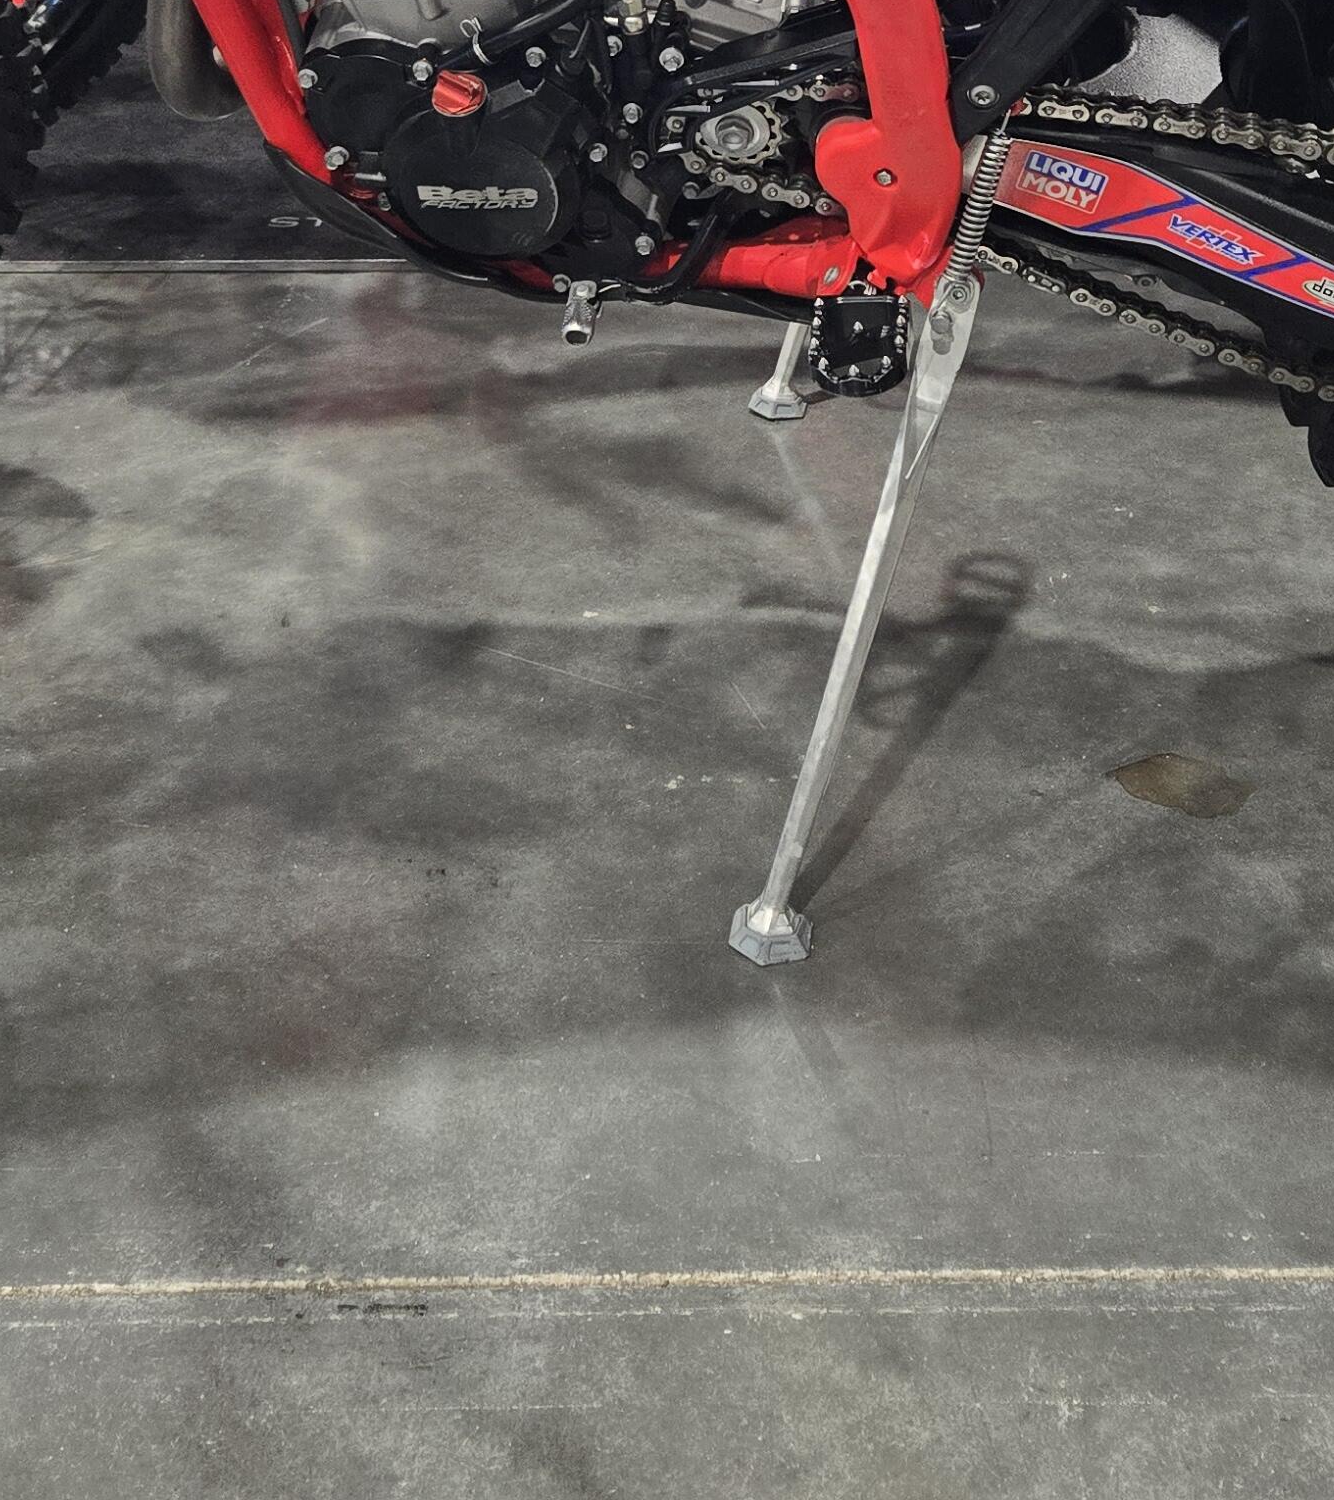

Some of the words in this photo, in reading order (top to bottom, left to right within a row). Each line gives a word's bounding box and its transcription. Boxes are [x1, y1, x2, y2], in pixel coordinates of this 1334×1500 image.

[1029, 153, 1106, 191] LIQUI
[417, 185, 539, 202] Beta
[1021, 174, 1098, 210] MOLY
[1171, 214, 1262, 263] VERTEX
